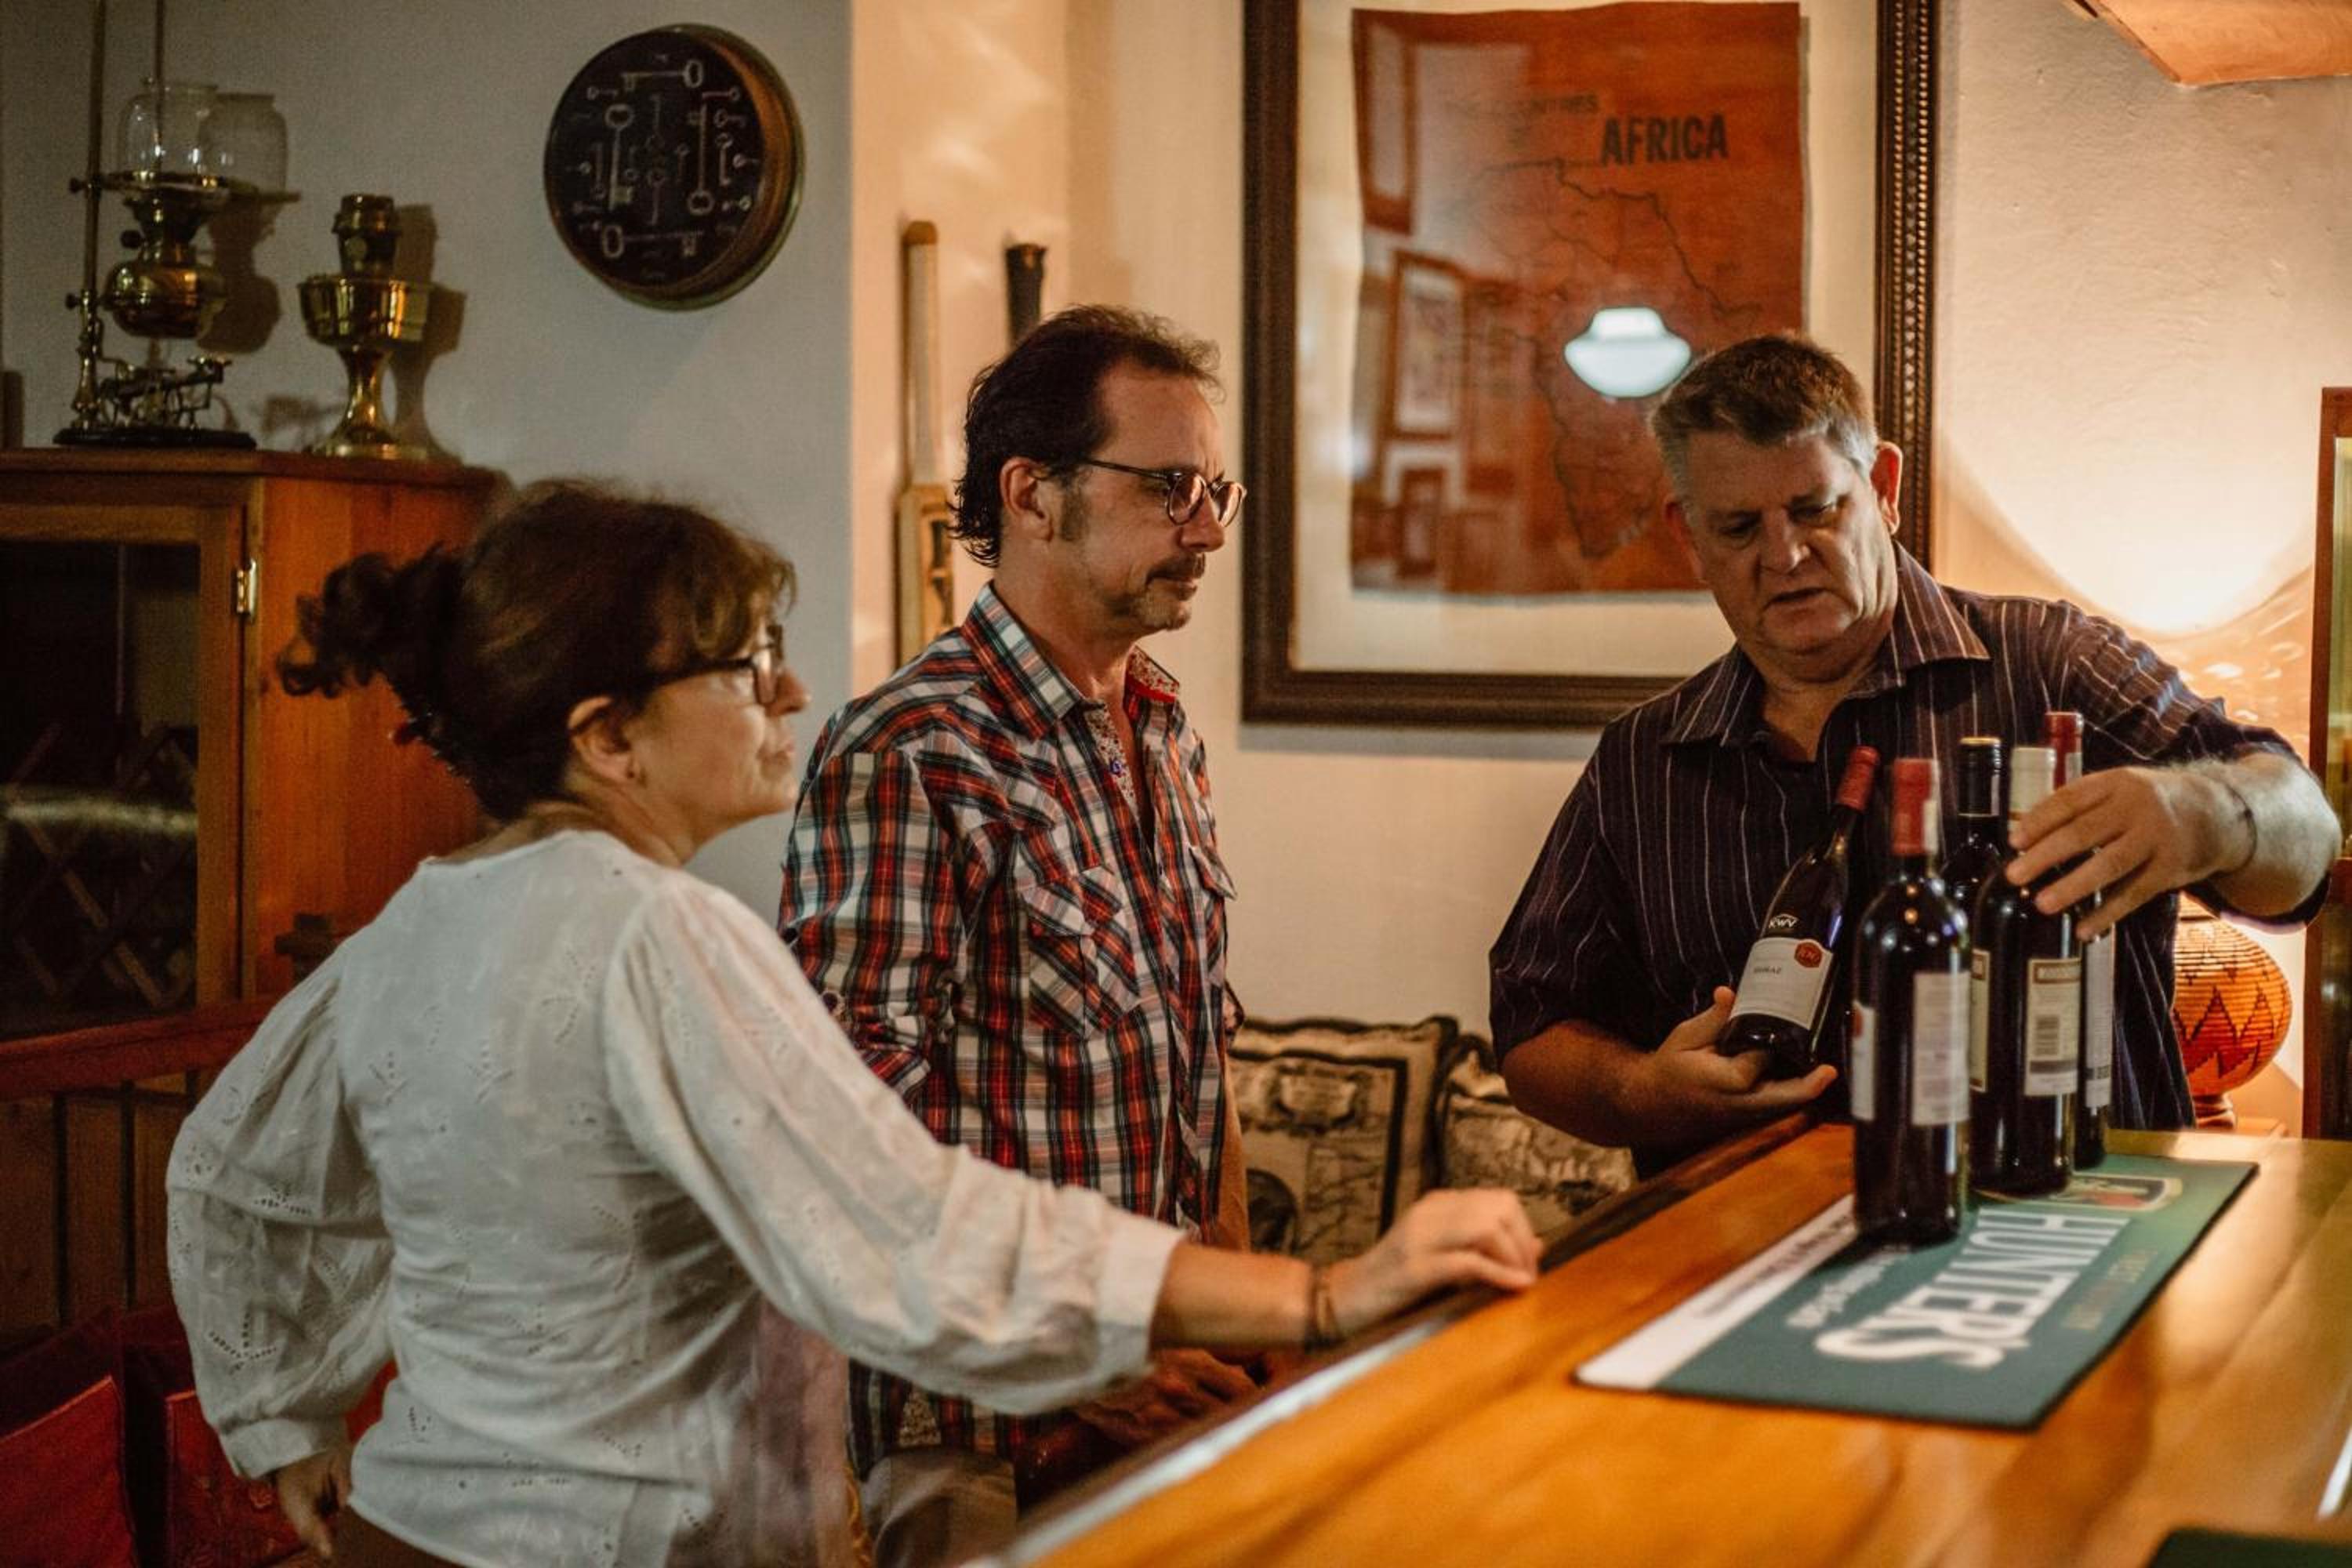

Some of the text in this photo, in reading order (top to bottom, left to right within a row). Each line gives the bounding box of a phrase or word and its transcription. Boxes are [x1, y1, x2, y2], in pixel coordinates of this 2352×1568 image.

[1601, 112, 1730, 166] AFRICA
[1768, 916, 1797, 928] KWV
[1814, 1207, 2132, 1370] HUNTER'S
